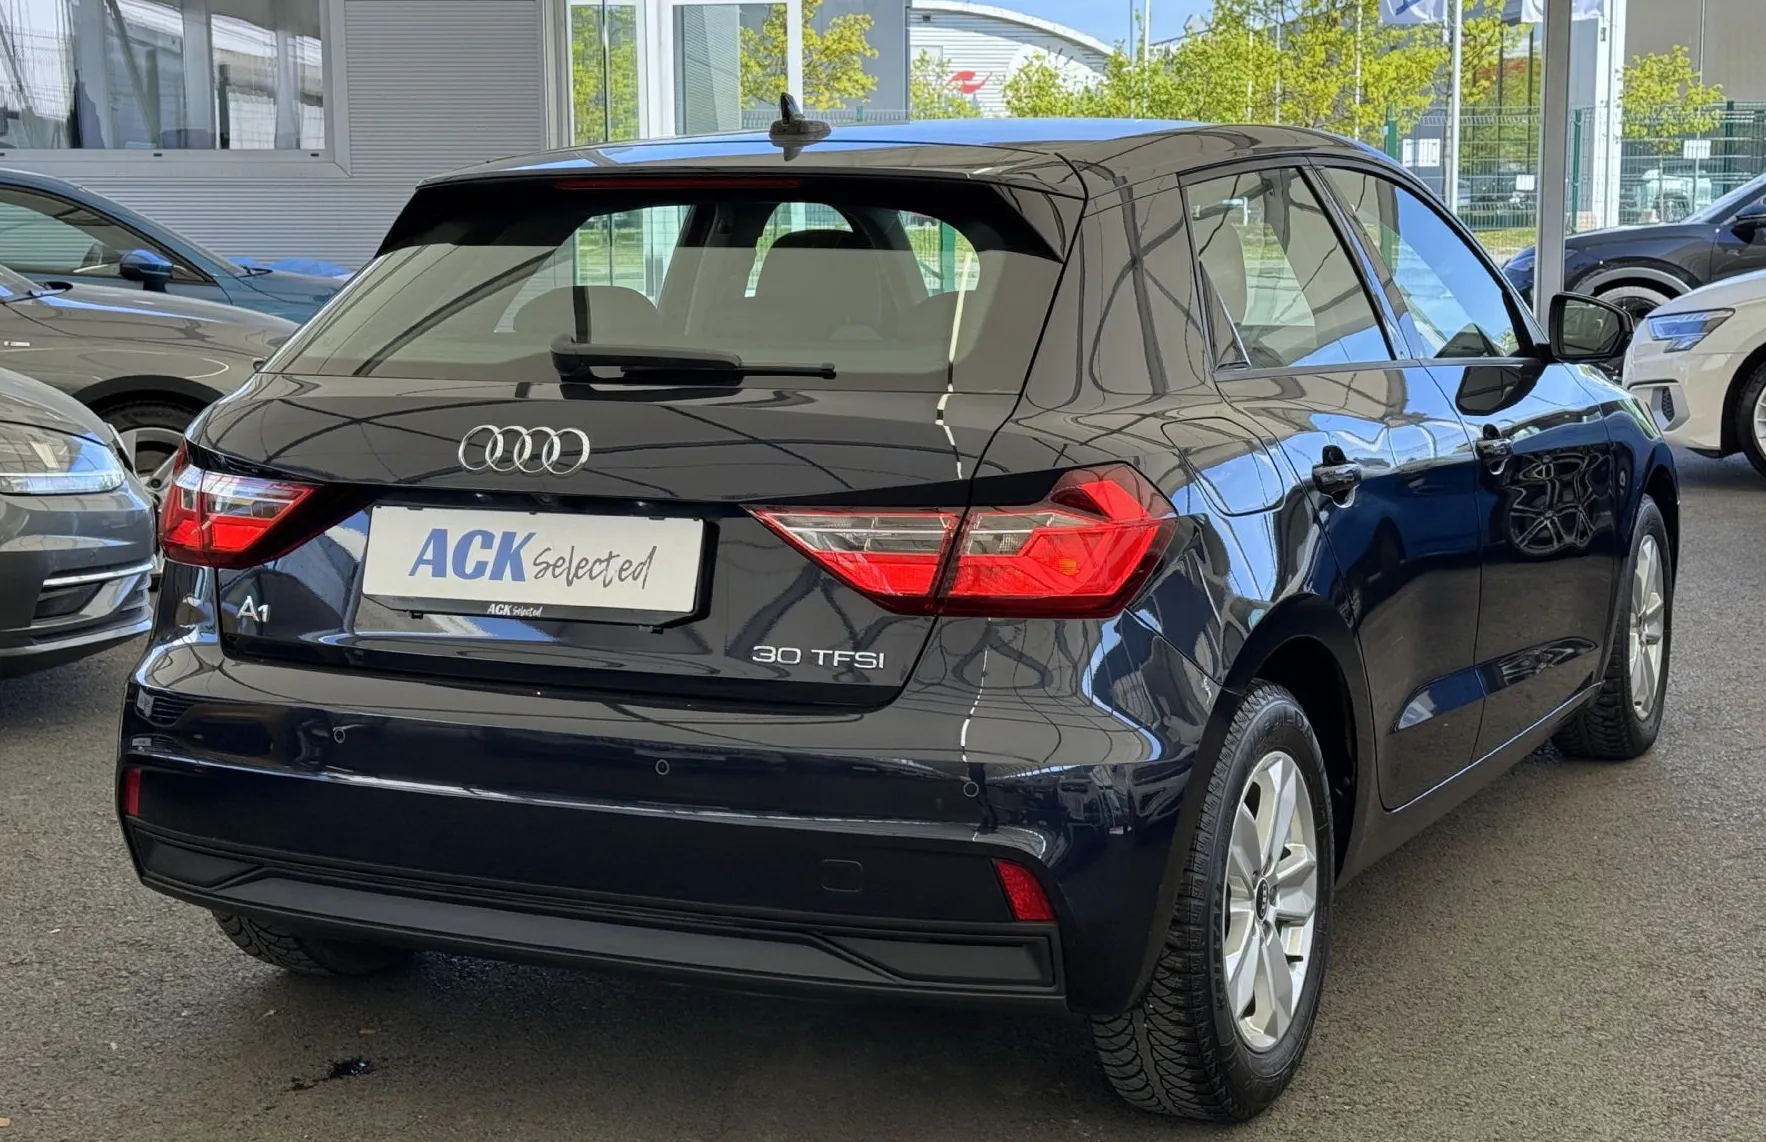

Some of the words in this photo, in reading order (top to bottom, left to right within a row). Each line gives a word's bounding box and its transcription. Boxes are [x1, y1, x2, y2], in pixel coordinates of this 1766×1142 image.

[408, 528, 537, 582] ACK
[533, 545, 657, 590] Selected
[236, 595, 269, 622] A1
[486, 603, 513, 616] ACK
[752, 645, 801, 665] 30
[811, 649, 885, 669] TFSI
